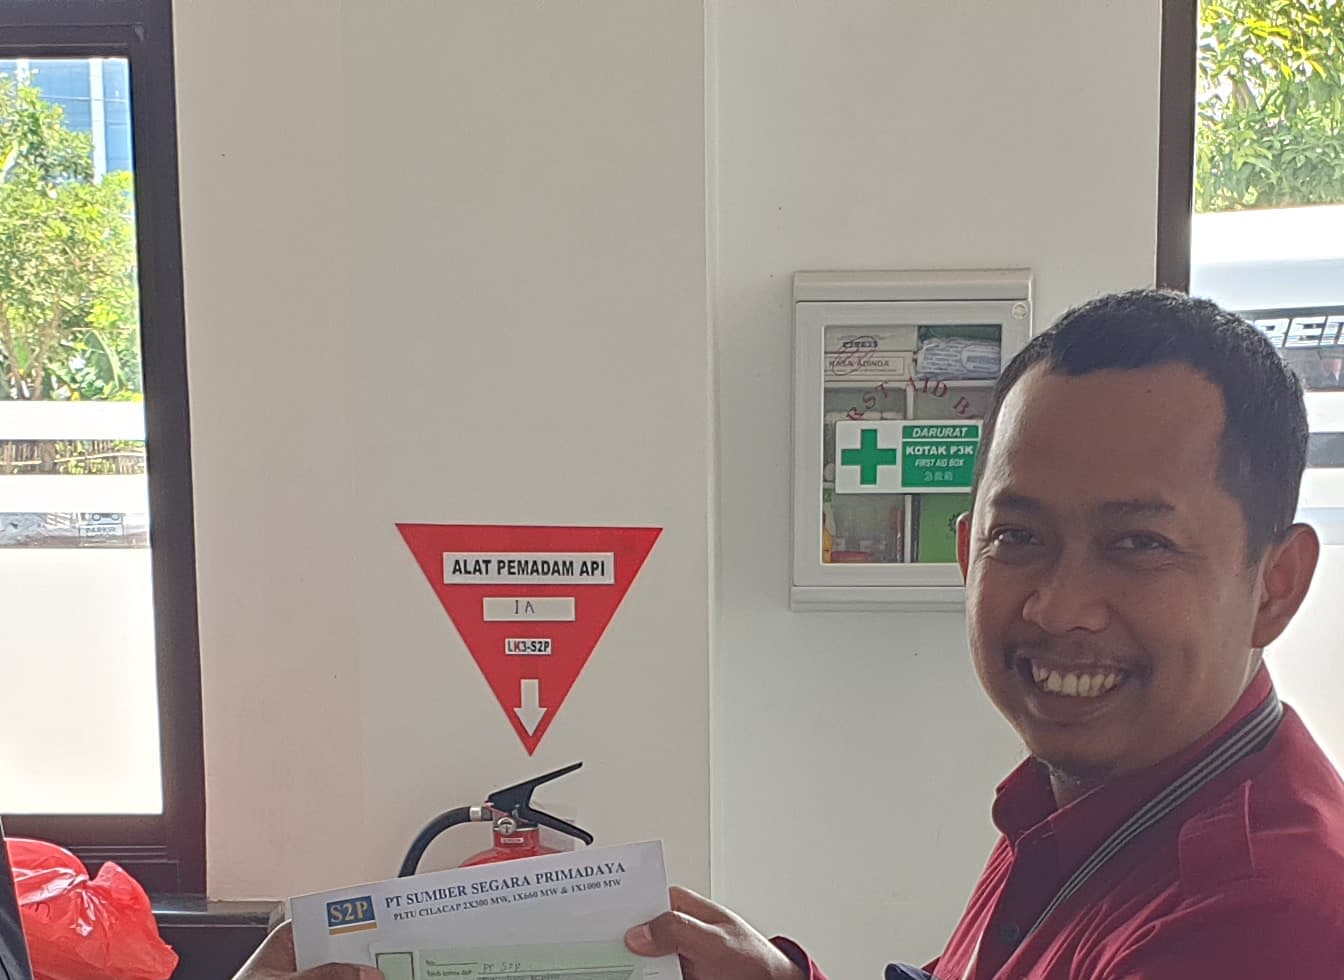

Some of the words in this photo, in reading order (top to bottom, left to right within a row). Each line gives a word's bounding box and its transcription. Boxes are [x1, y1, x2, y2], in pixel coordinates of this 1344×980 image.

[912, 427, 968, 437] DARURAT
[906, 445, 947, 455] KOTAK
[950, 445, 973, 455] P3K
[452, 559, 492, 575] ALAT
[497, 560, 574, 576] PEMADAM
[579, 561, 605, 577] API
[507, 640, 550, 653] LK3-S2P
[384, 895, 402, 908] PT
[406, 885, 467, 905] SUMBER
[471, 875, 531, 895] SEGARA
[536, 862, 626, 884] PRIMADAYA
[393, 910, 416, 920] PLTU
[418, 903, 461, 917] CILACAP
[603, 879, 622, 889] MW
[330, 901, 369, 923] S2P
